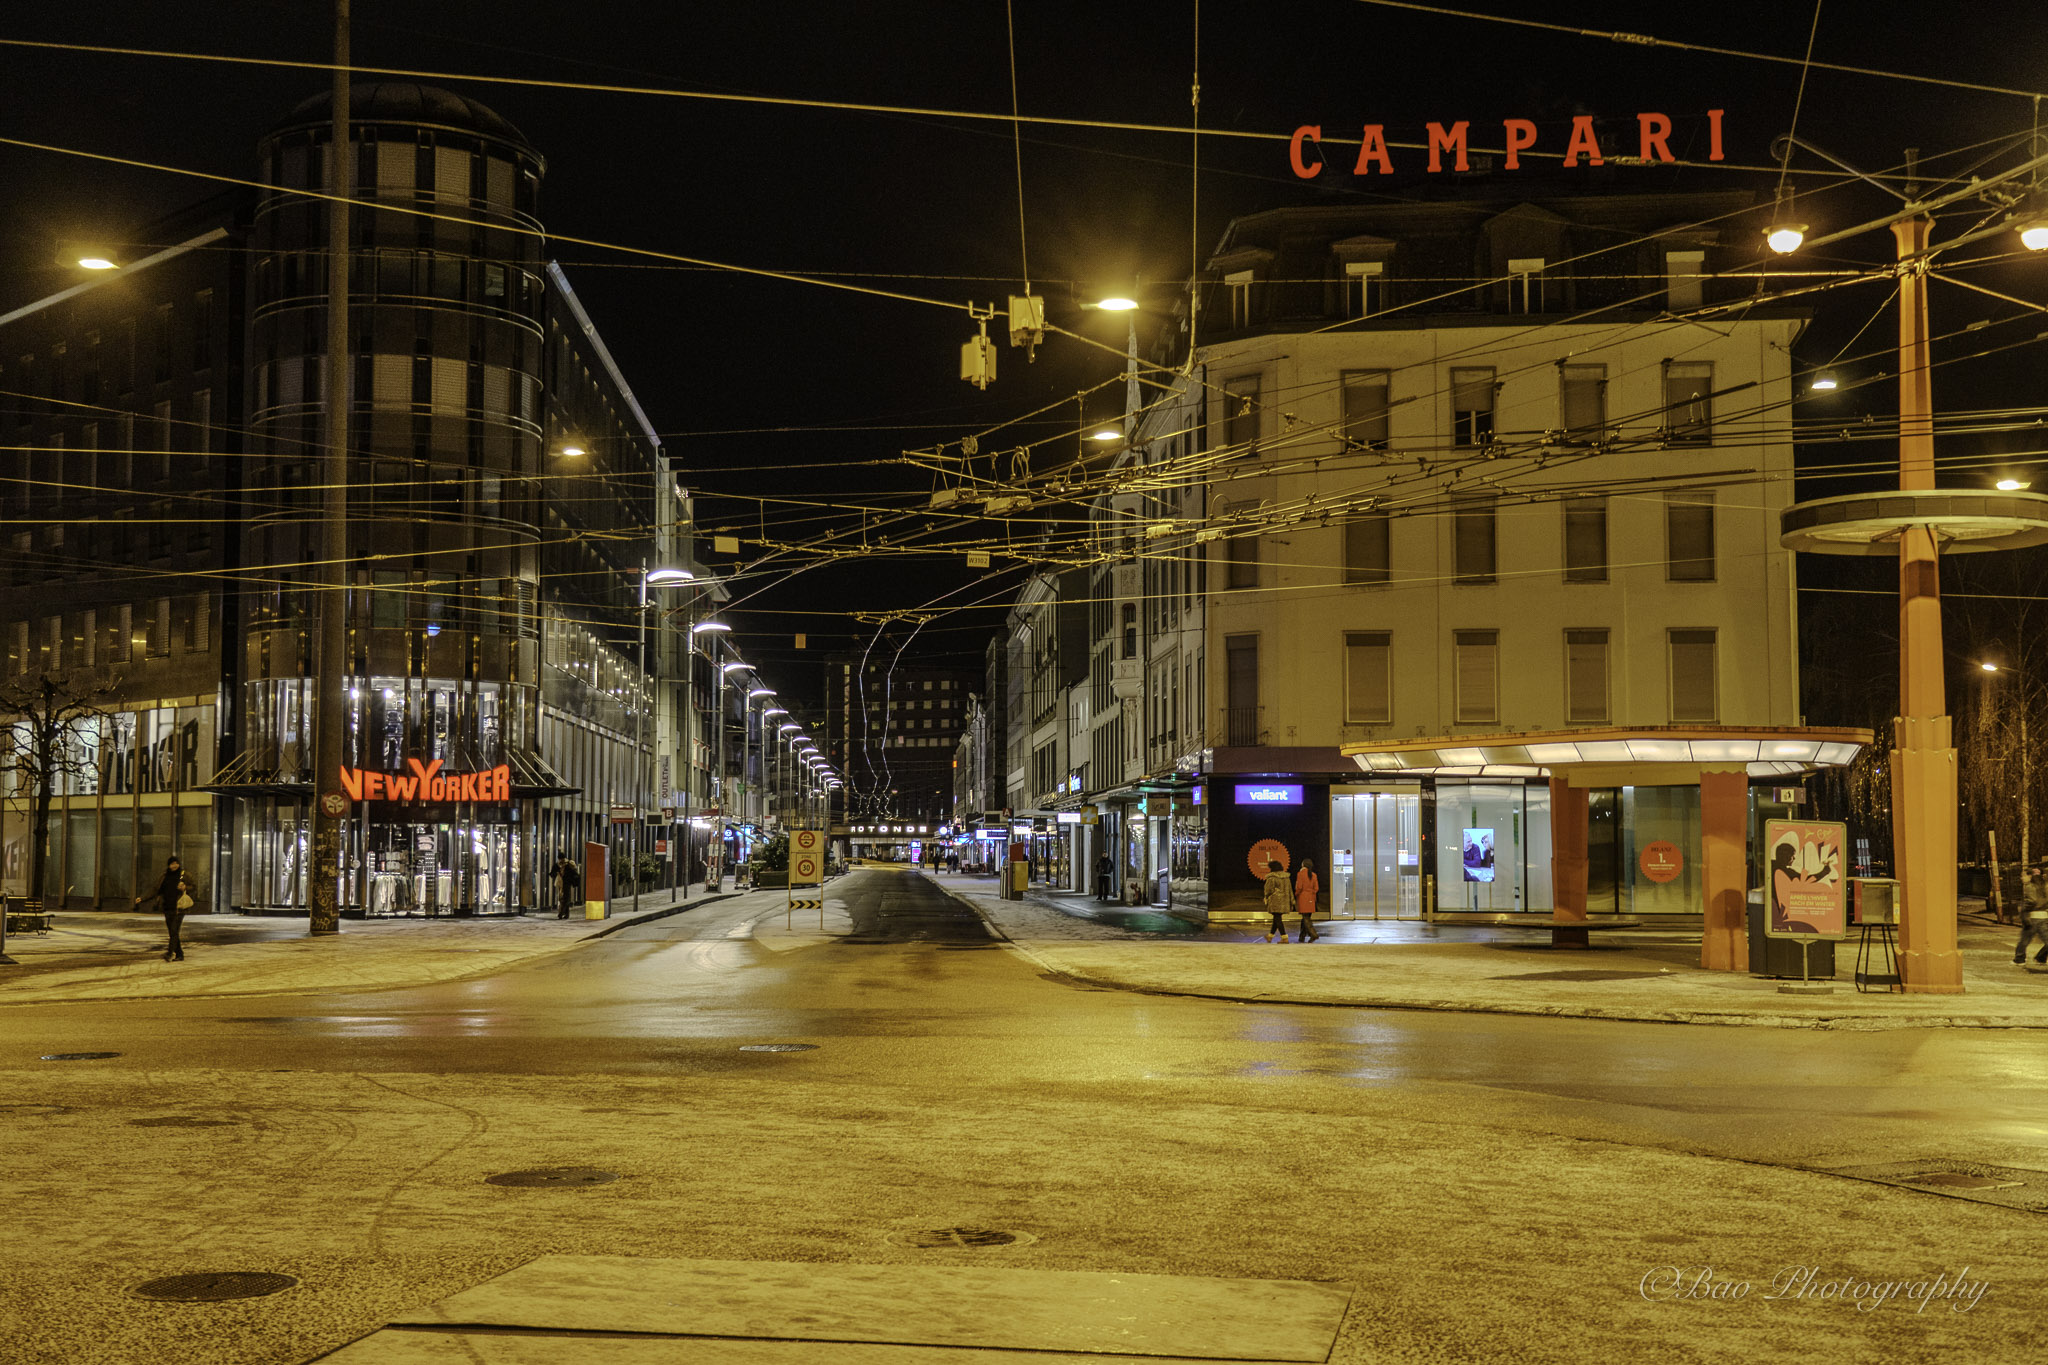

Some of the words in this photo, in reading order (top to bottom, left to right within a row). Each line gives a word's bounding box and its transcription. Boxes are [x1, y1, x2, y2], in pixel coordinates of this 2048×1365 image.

[1289, 109, 1725, 179] CAMPARI
[340, 764, 419, 802] NEW
[408, 758, 510, 802] YORKER
[661, 771, 669, 799] OUTLET
[1249, 789, 1289, 801] valiant
[666, 809, 673, 818] B
[1003, 809, 1012, 817] A
[850, 825, 928, 833] ROTONDE
[1658, 852, 1667, 864] 1.
[802, 864, 811, 872] 30
